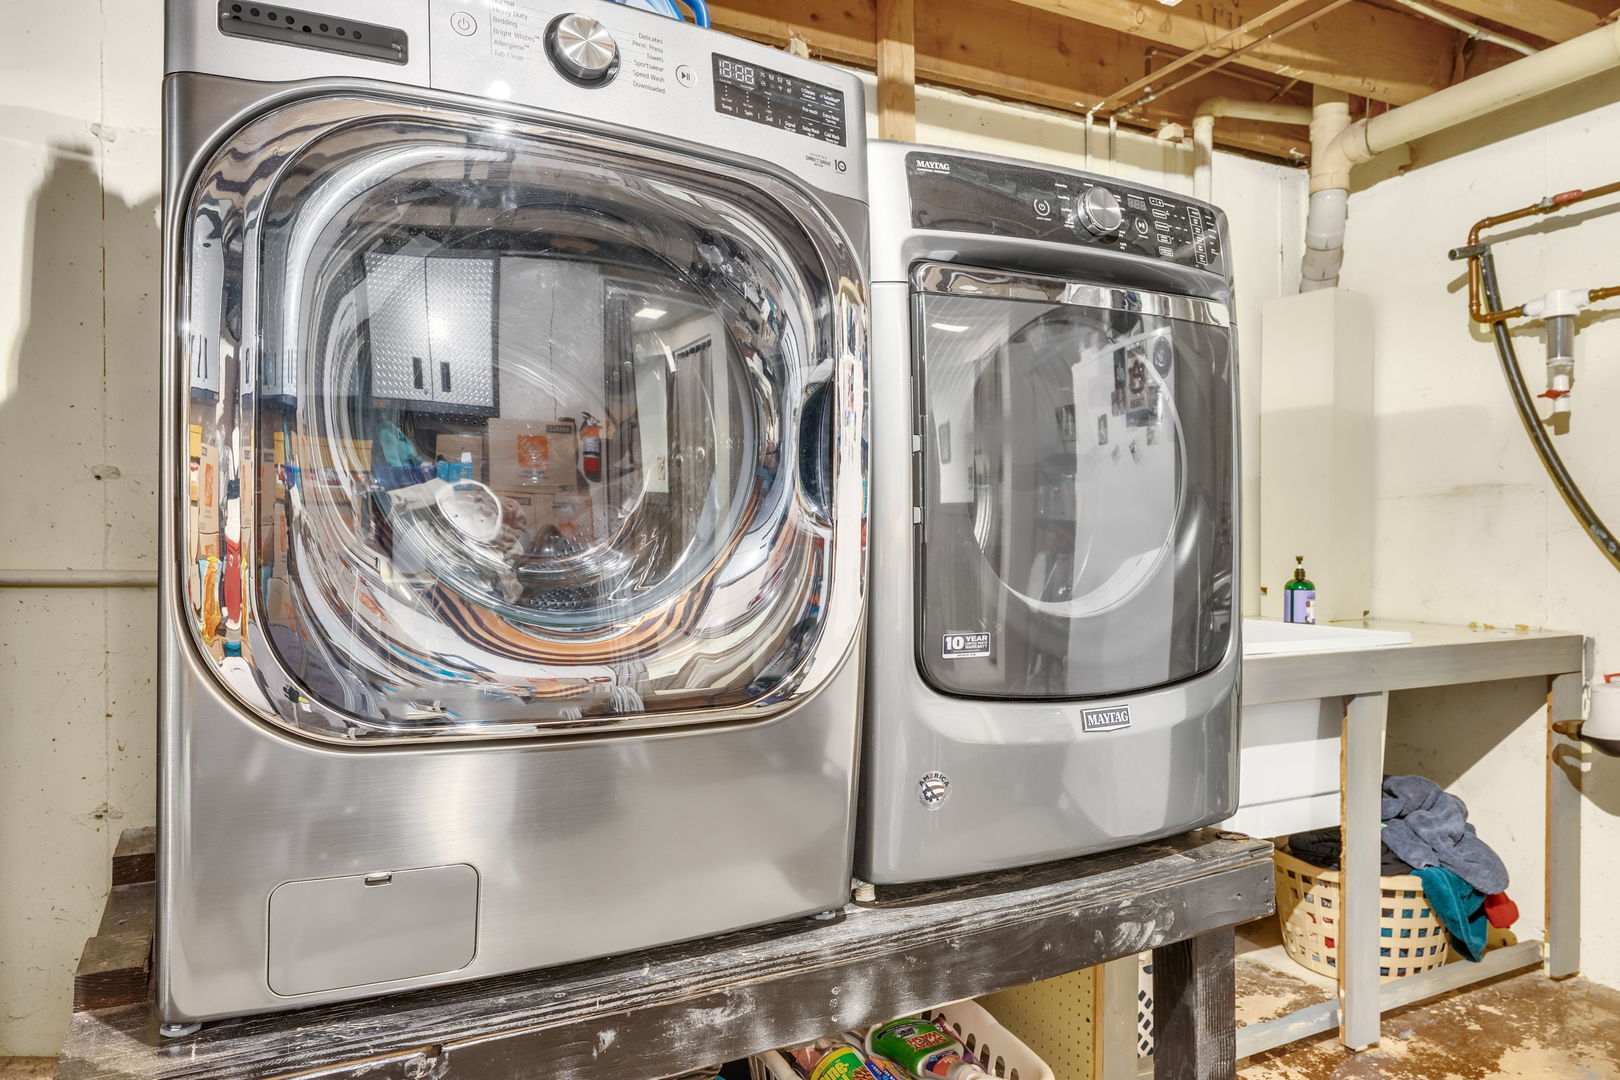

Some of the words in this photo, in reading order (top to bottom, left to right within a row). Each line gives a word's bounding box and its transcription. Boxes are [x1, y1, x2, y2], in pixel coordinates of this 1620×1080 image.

[492, 16, 518, 28] Bedding
[492, 28, 512, 38] Bright
[638, 32, 664, 44] Delicates
[648, 44, 664, 54] Press
[646, 52, 664, 63] Towels
[634, 59, 665, 72] Sportswear
[632, 69, 650, 79] Speed
[650, 74, 666, 83] Wash
[632, 80, 666, 94] Downloaded
[916, 159, 950, 171] MAYTAG
[945, 636, 965, 650] 10
[965, 634, 988, 643] YEAR
[1086, 710, 1129, 726] MAYTAG
[919, 772, 950, 788] AMERICA
[907, 1031, 943, 1046] WASH
[913, 1036, 949, 1051] SPRAY
